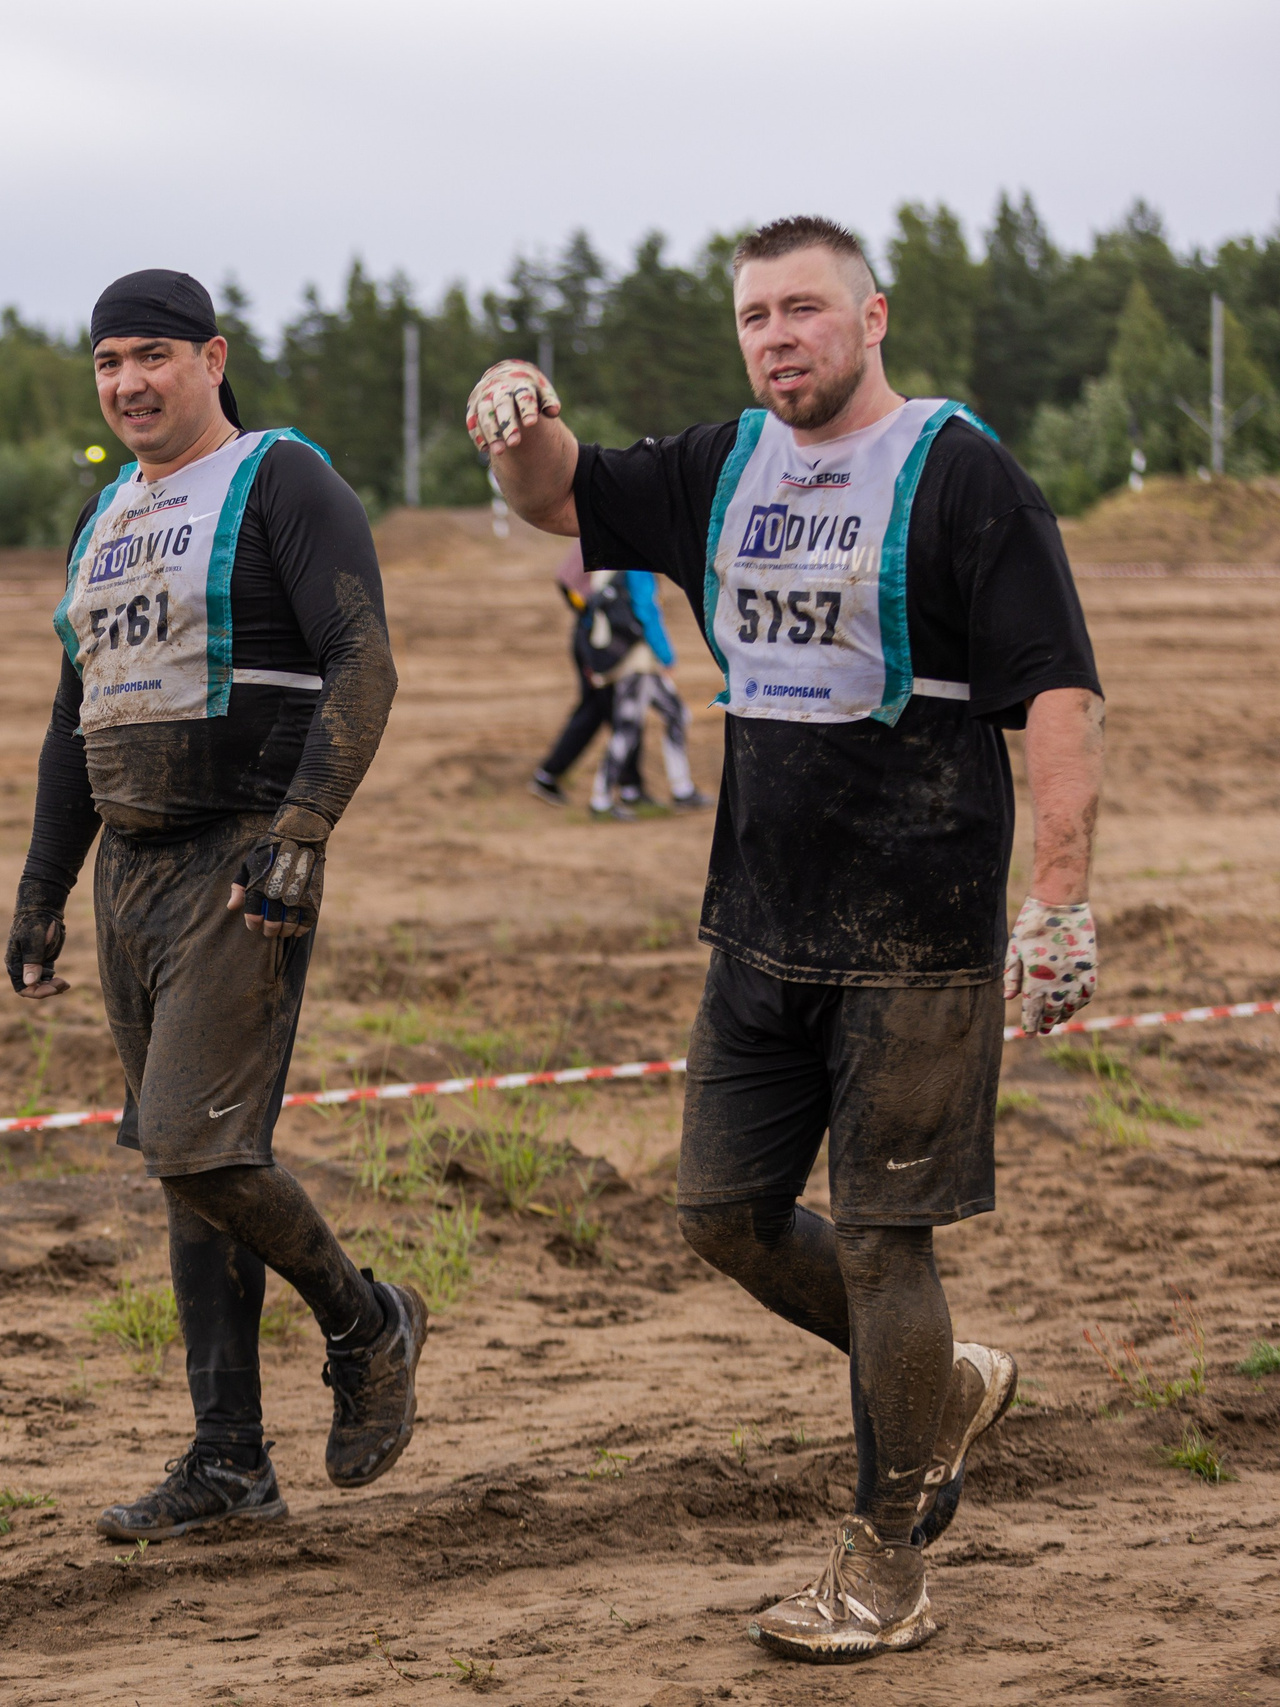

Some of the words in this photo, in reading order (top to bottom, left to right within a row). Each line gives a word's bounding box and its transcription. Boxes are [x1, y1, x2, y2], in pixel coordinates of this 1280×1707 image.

[151, 495, 189, 511] ГЕРОЕВ
[91, 524, 193, 579] RODVIG
[742, 512, 862, 552] RODVIG
[86, 590, 169, 655] 5161
[737, 588, 842, 646] 5157
[103, 678, 162, 697] ГАЗПРОМБАНК
[762, 684, 832, 699] ГАЗПРОМБАНК
